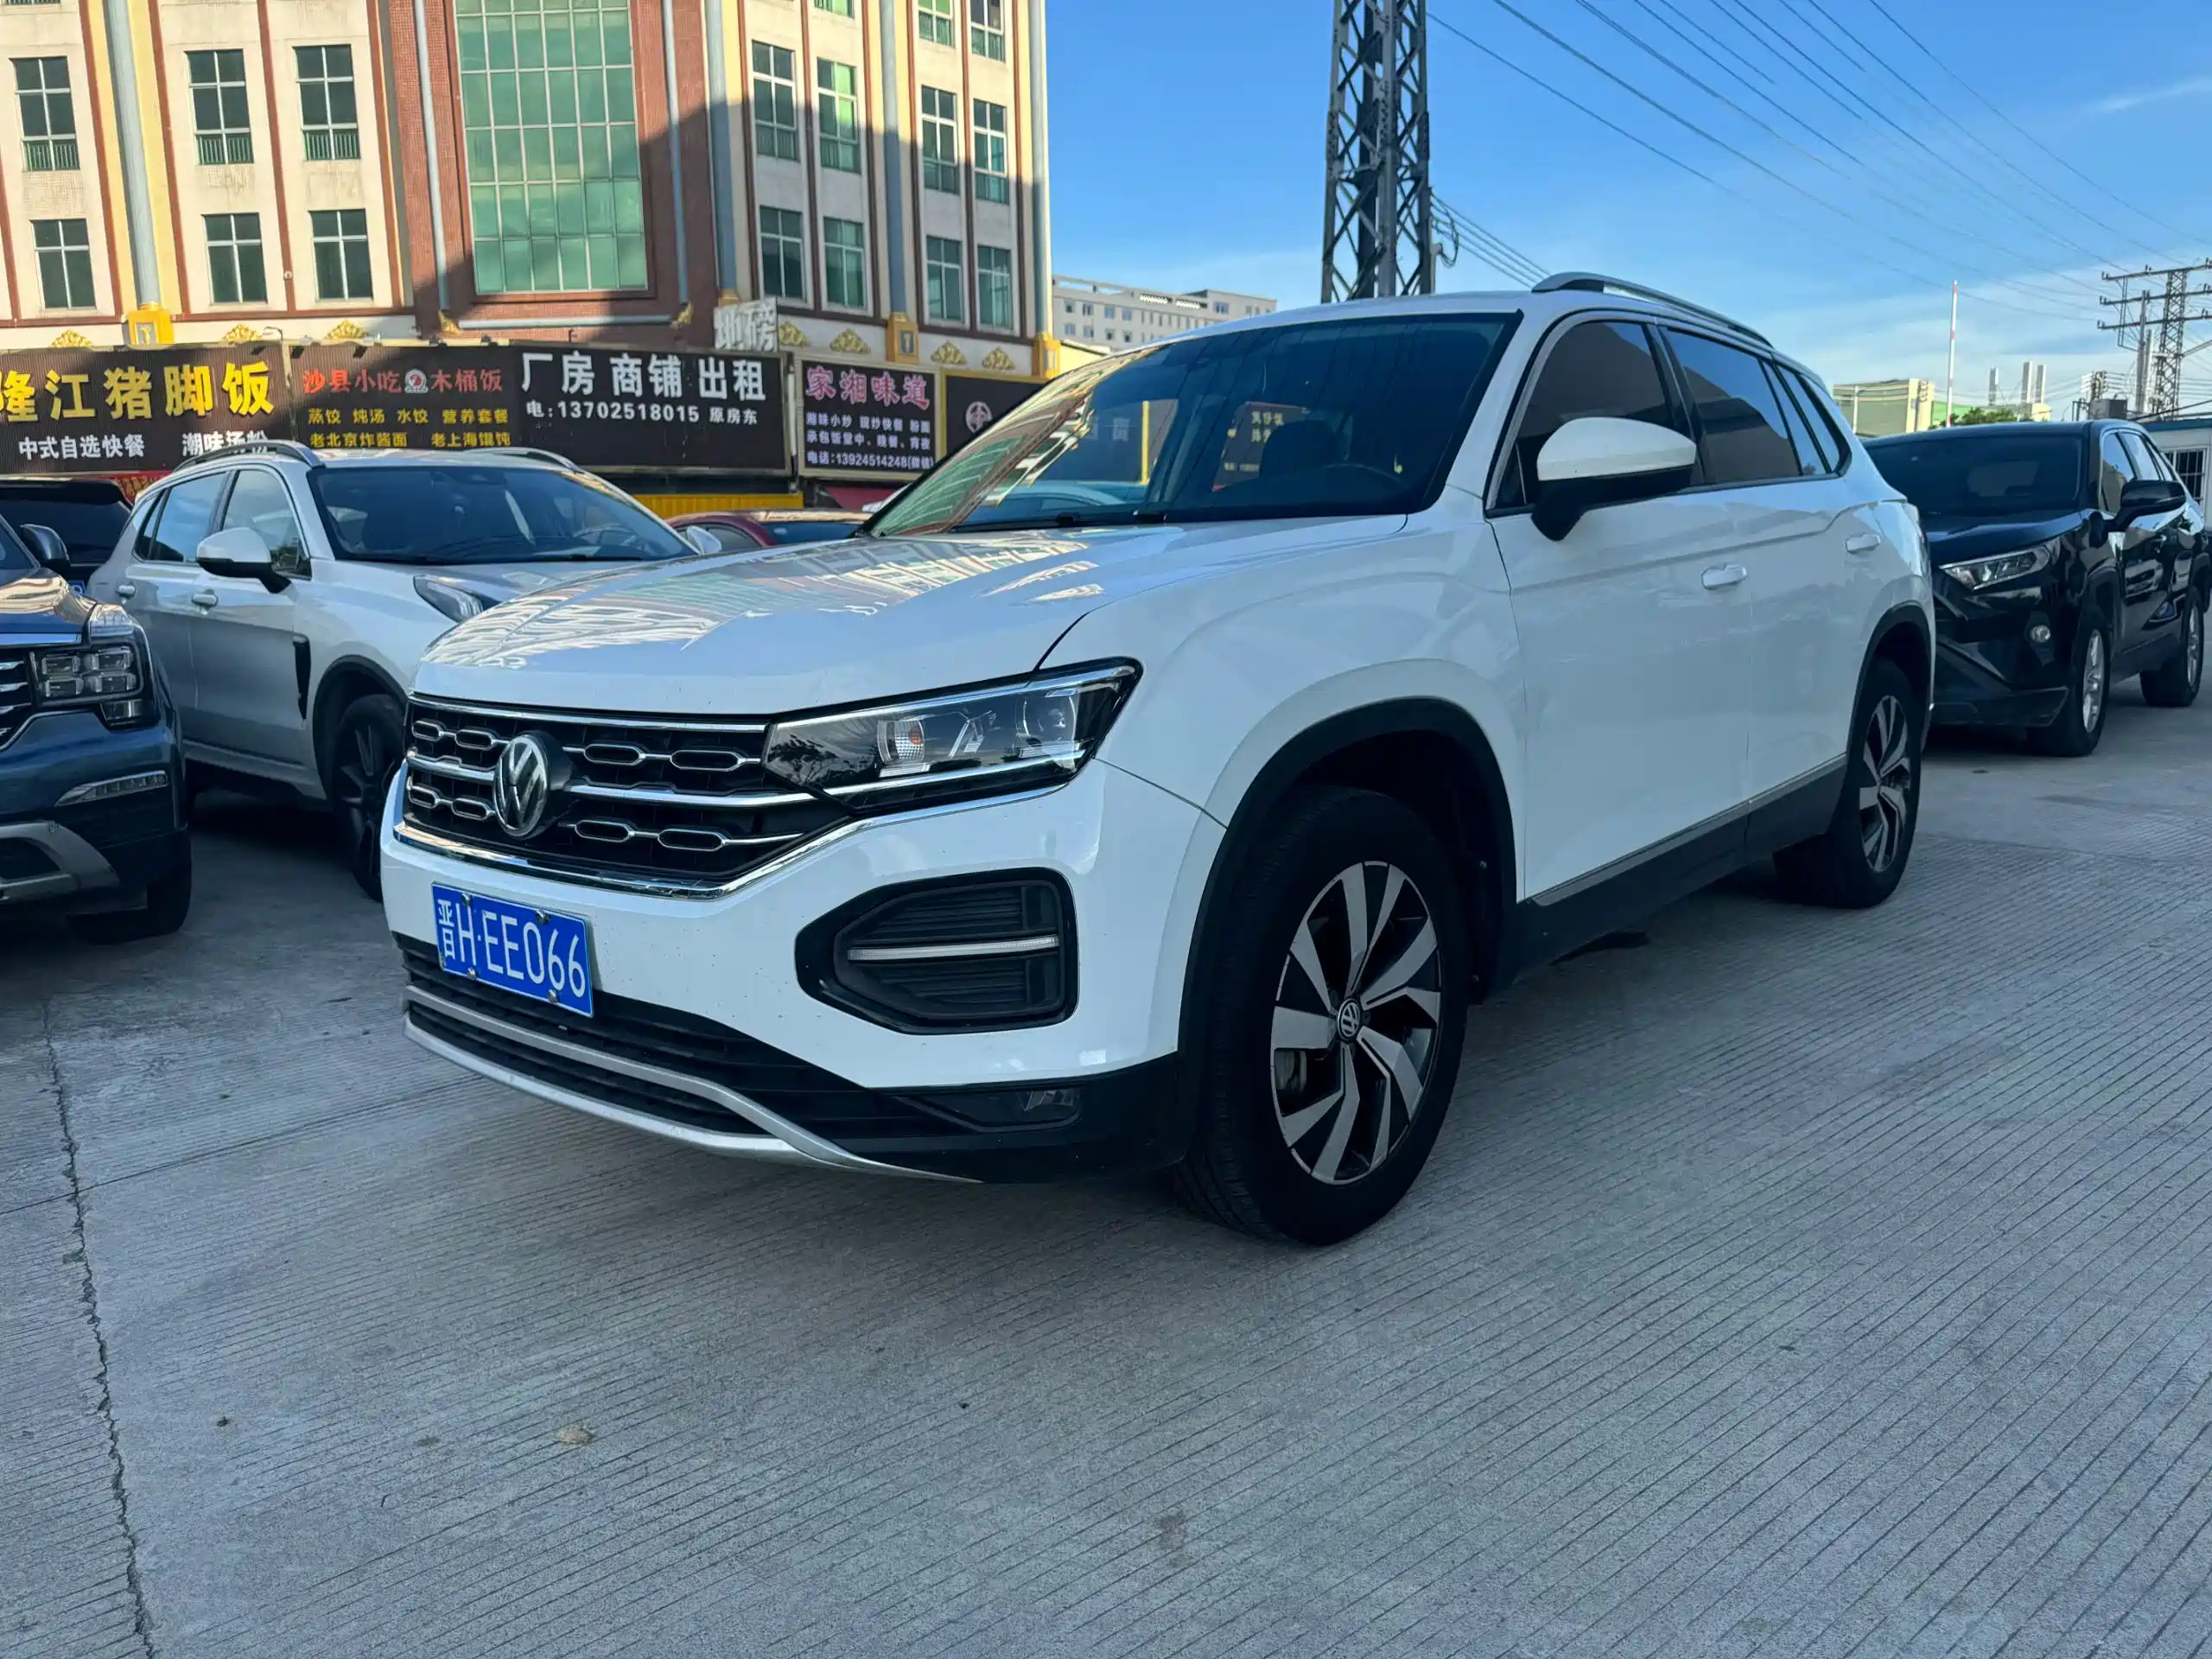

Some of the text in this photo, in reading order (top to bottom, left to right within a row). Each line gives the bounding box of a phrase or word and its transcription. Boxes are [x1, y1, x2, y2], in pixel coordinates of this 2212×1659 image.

[303, 369, 503, 394] 沙县小吃 木桶饭
[521, 351, 766, 402] 厂房 商铺 出租
[805, 365, 930, 410] 家湘味道
[0, 361, 274, 422] 隆江猪脚饭
[397, 408, 429, 425] 水饺
[442, 408, 509, 425] 营养套餐
[709, 406, 758, 425] 原房东
[19, 434, 145, 461] 中式自选快餐
